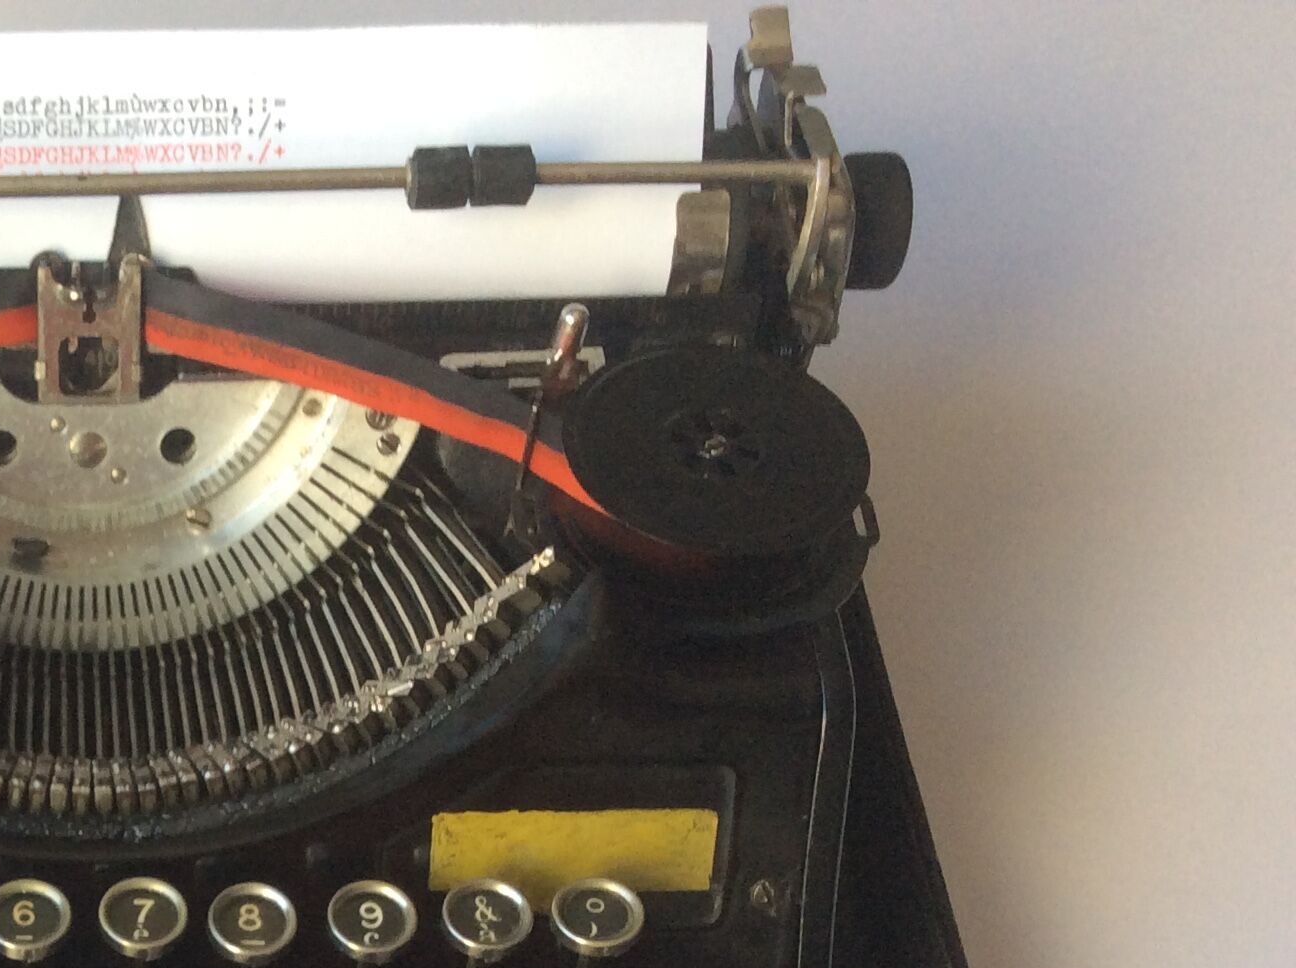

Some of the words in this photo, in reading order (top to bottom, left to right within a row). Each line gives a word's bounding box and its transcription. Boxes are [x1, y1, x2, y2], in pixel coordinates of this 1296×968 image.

[11, 900, 36, 926] 6
[133, 898, 155, 923] 7
[238, 903, 263, 931] 8
[359, 901, 384, 929] 9
[475, 896, 502, 922] &
